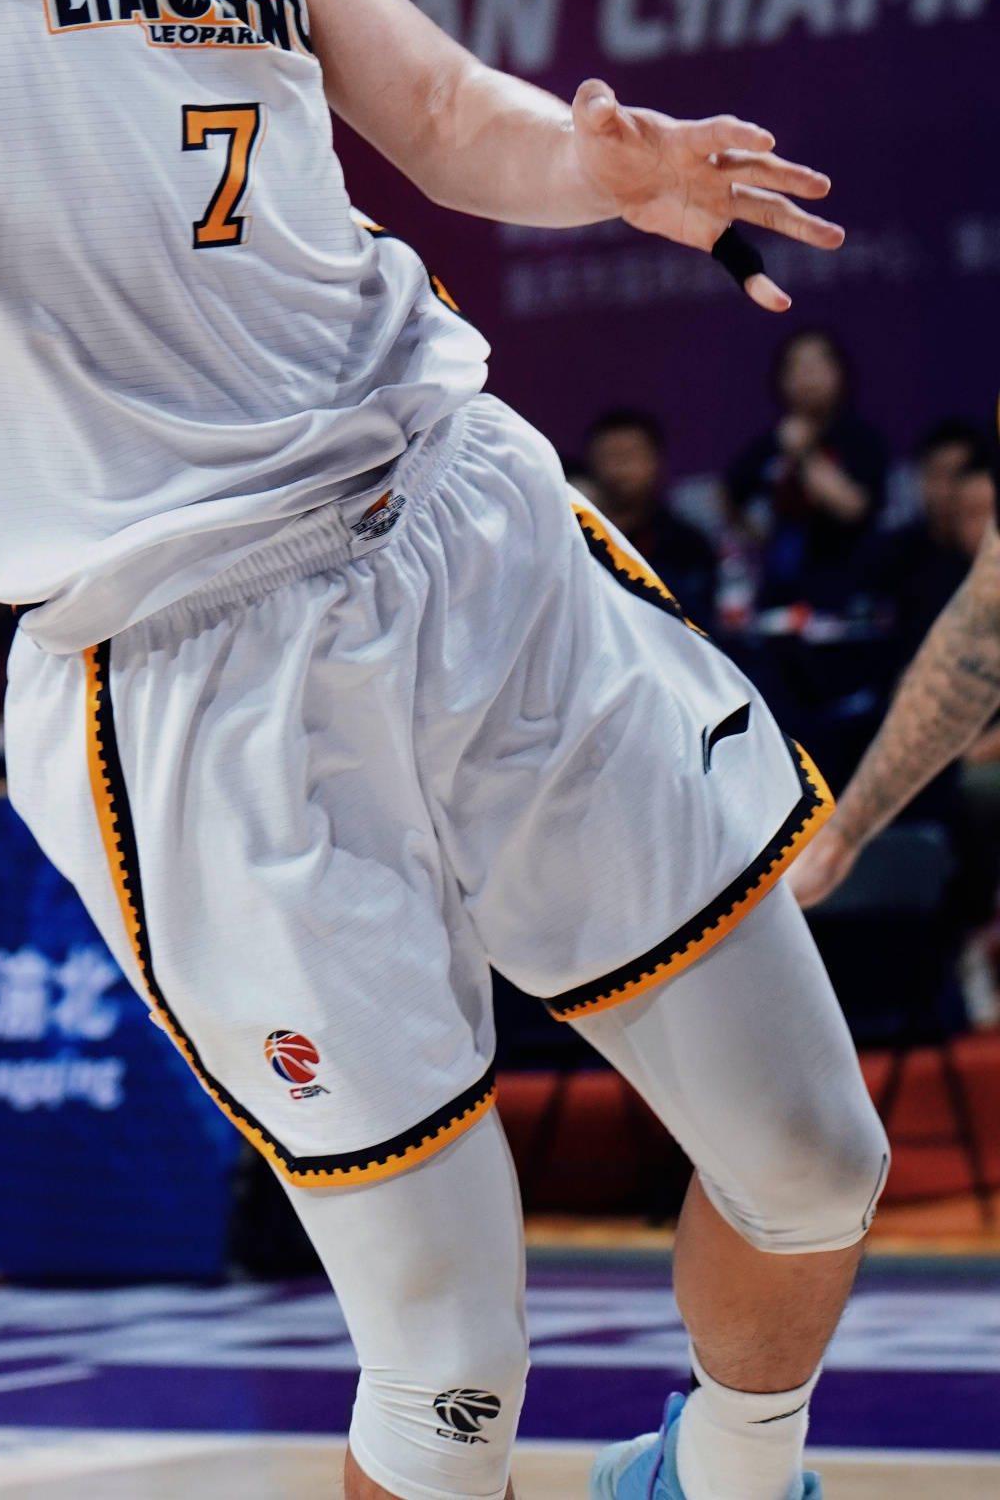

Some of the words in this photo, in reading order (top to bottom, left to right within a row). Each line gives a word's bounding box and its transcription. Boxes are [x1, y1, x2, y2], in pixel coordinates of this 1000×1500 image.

[147, 25, 264, 45] LEOPAR
[181, 102, 268, 250] 7
[436, 1427, 489, 1445] CBA
